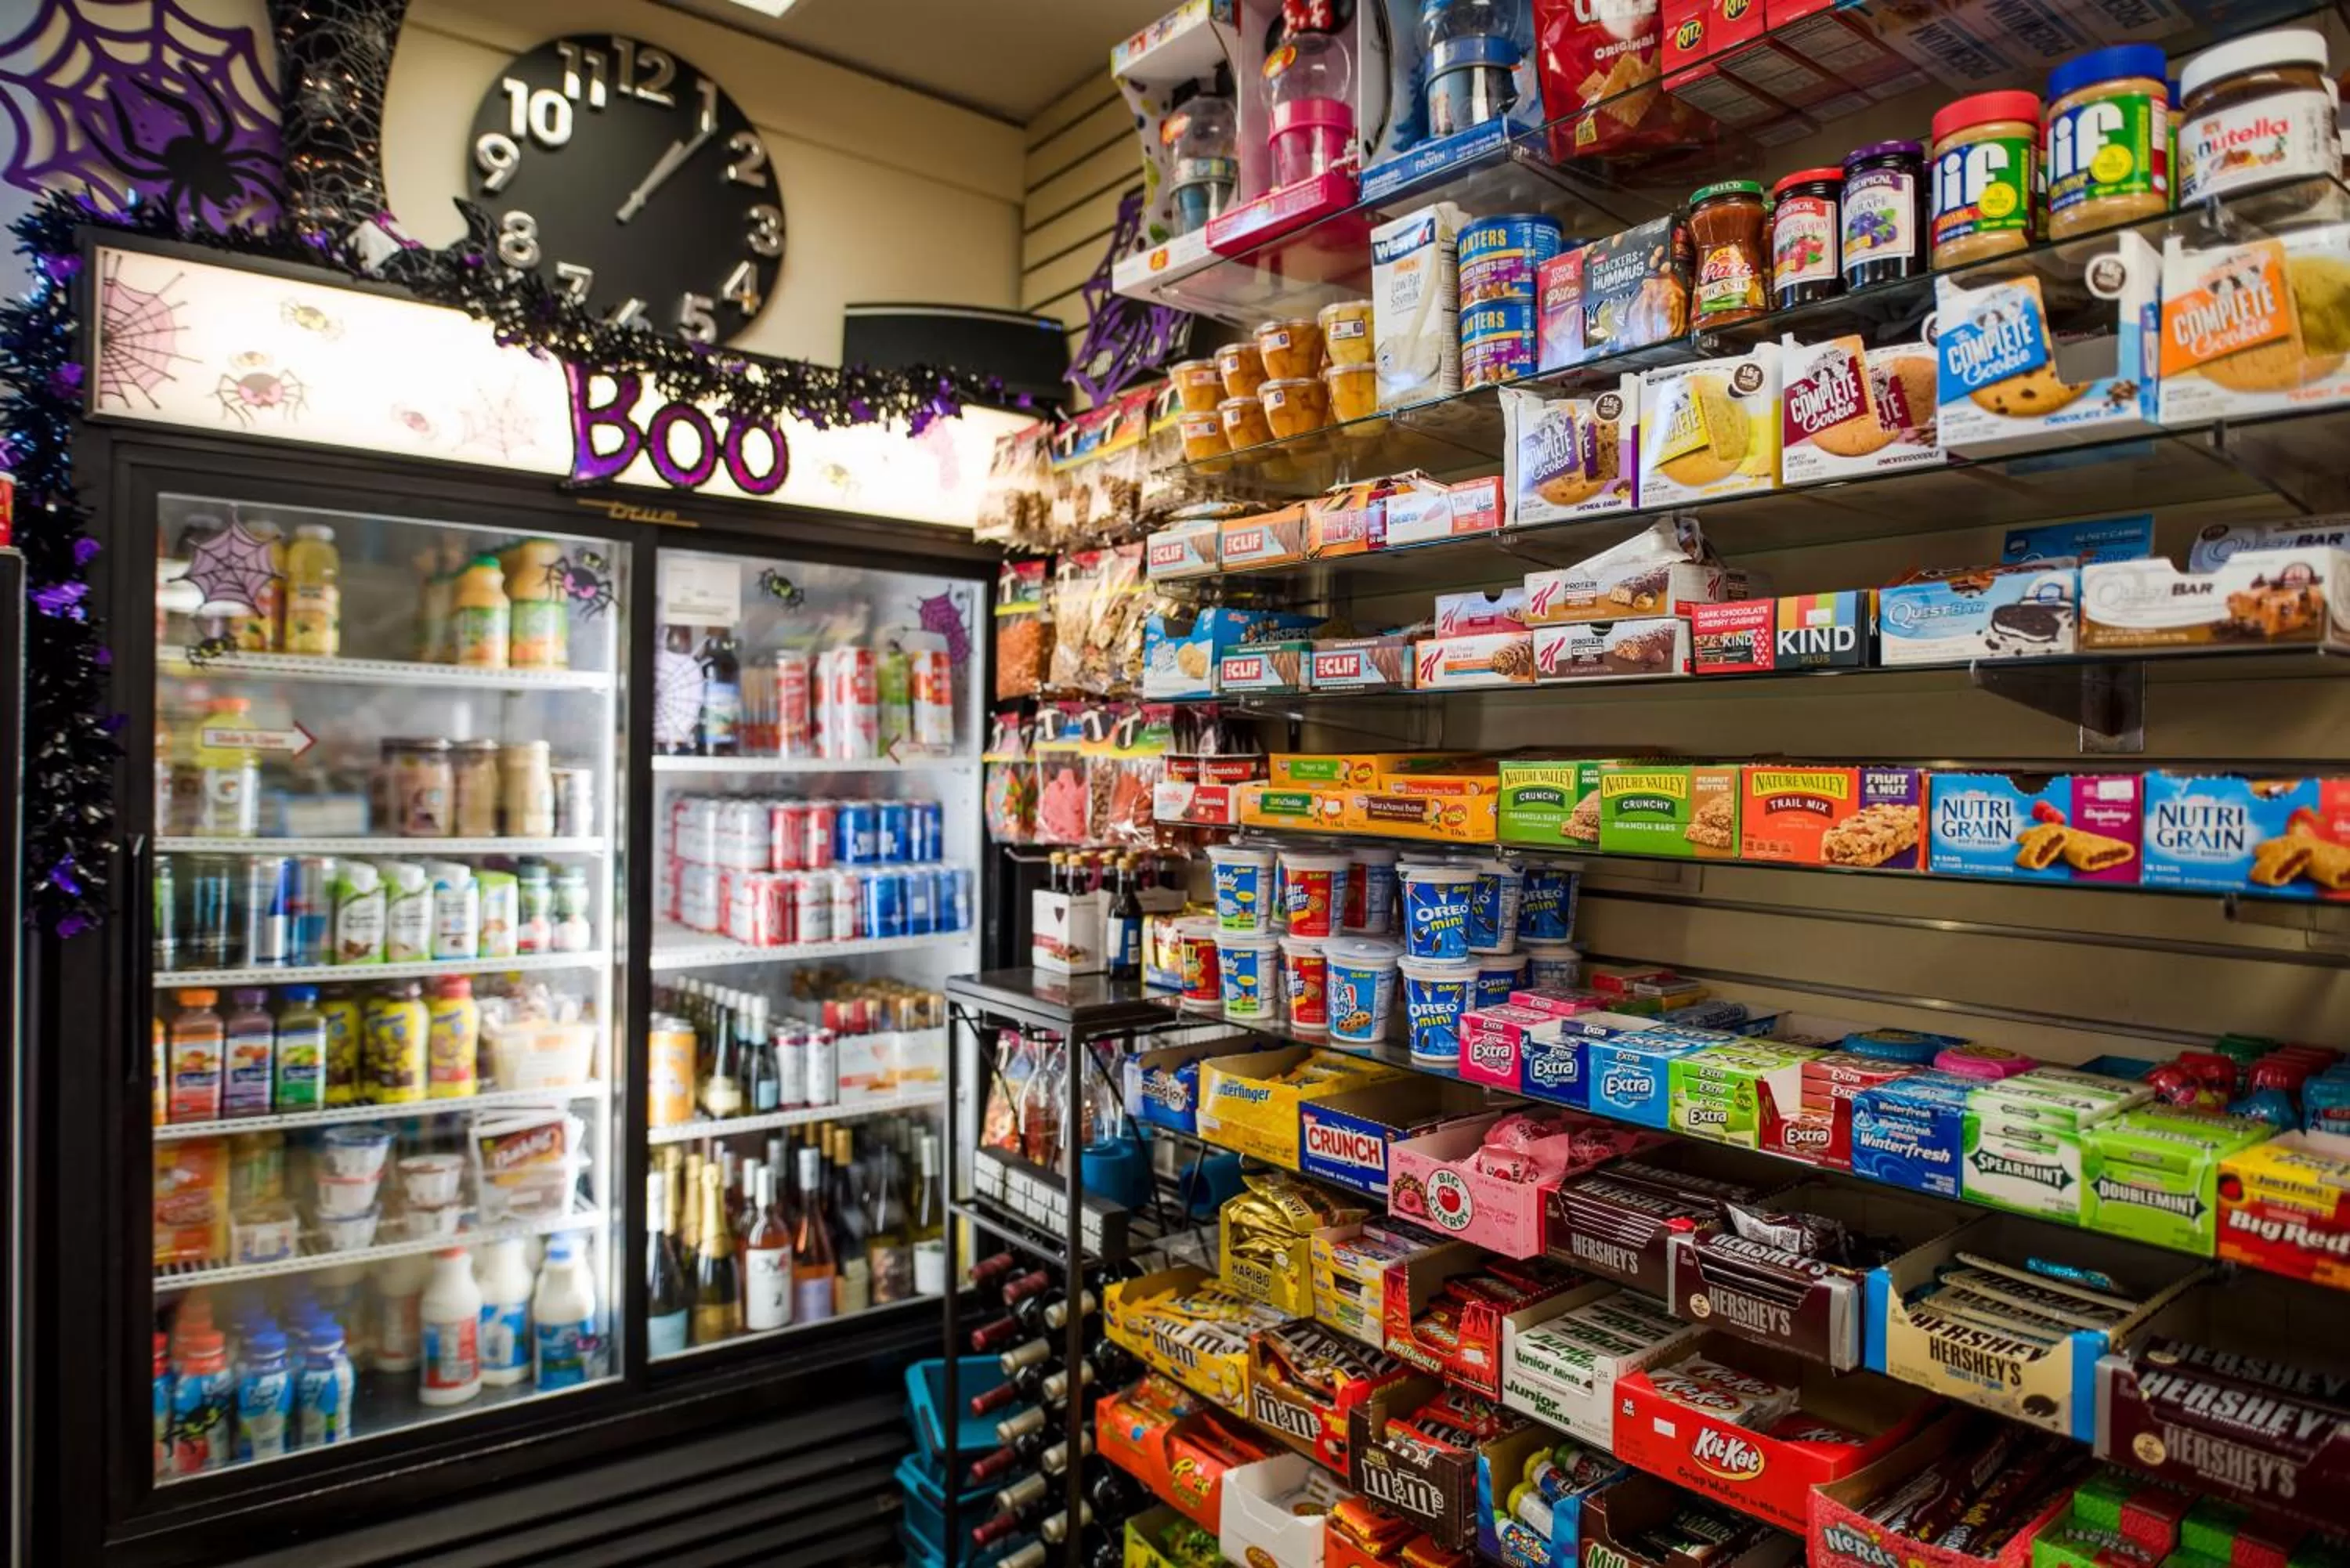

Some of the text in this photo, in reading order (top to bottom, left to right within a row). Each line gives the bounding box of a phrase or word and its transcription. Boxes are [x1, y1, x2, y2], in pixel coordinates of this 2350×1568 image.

[1676, 21, 1704, 49] RITZ
[1593, 34, 1656, 60] ORIGINAL
[558, 40, 607, 107] 11
[611, 35, 676, 108] 12
[502, 77, 573, 146] 10
[696, 78, 719, 132] 1
[2046, 101, 2124, 188] Jif
[2198, 117, 2290, 157] nutella
[475, 132, 520, 191] 9
[727, 130, 768, 188] 2
[1932, 142, 2009, 219] Jif
[498, 210, 542, 268] 8
[747, 203, 784, 257] 3
[556, 260, 595, 303] 7
[722, 260, 761, 315] 4
[1593, 262, 1644, 292] HUMMUS
[678, 291, 717, 343] 5
[2171, 282, 2276, 345] COMPLETE
[1947, 316, 2034, 376] COMPLETE
[2191, 318, 2272, 359] Cookie
[1962, 349, 2031, 386] Cookie
[1790, 365, 1859, 424] COMPLETE
[1802, 402, 1857, 432] Cookie
[1233, 531, 1261, 553] CLIF
[2296, 532, 2344, 547] BAR
[1158, 544, 1184, 562] CLIF
[2171, 580, 2214, 597] BAR
[1697, 606, 1768, 620] DARK CHOCOLATE
[1697, 617, 1729, 627] CHERRY
[1723, 634, 1754, 648] KIND
[1776, 626, 1856, 656] KIND
[1231, 660, 1260, 679] CLIF
[1325, 656, 1358, 676] CLIF
[1503, 769, 1573, 785] NATURE VALLEY
[1603, 775, 1687, 796] NATURE VALLEY
[1753, 773, 1846, 796] NATURE VALLEY
[1865, 773, 1908, 784] FRUIT
[1518, 790, 1560, 802] CRUNCHY
[1880, 784, 1908, 796] NUT
[1622, 799, 1671, 811] CRUNCHY
[1769, 797, 1829, 814] TRAIL MIX
[1942, 798, 2011, 818] NUTRI
[2159, 803, 2245, 826] NUTRI
[1654, 822, 1676, 832] BARS
[1941, 820, 2012, 840] GRAIN
[2157, 829, 2245, 851] GRAIN
[1415, 905, 1469, 922] OREO
[1430, 917, 1464, 931] mini
[1410, 1003, 1458, 1016] OREO
[1418, 1014, 1452, 1028] mini
[1483, 1019, 1504, 1031] Extra
[1582, 1024, 1607, 1036] Extra
[1472, 1044, 1510, 1060] Extra
[1549, 1046, 1572, 1058] Extra
[1615, 1050, 1640, 1063] Extra
[1534, 1059, 1574, 1078] Extra
[1698, 1066, 1726, 1078] Extra
[1831, 1069, 1861, 1082] Extra
[1605, 1076, 1650, 1094] Extra
[1698, 1082, 1726, 1094] Extra
[1689, 1108, 1727, 1123] Extra
[1879, 1100, 1932, 1119] Winterfresh
[1786, 1128, 1828, 1143] Extra
[1879, 1117, 1932, 1137] Winterfresh
[1308, 1126, 1380, 1165] CRUNCH
[1860, 1131, 1950, 1165] Winterfresh
[1437, 1172, 1459, 1190] BIG
[1978, 1153, 2065, 1187] SPEARMINT
[2099, 1177, 2196, 1217] DOUBLEMINT
[1429, 1194, 1471, 1229] CHERRY
[2229, 1209, 2350, 1255] Big Red
[1571, 1231, 1639, 1275] HERSHEY'S
[1708, 1233, 1827, 1277] HERSHEY'S
[1232, 1263, 1271, 1288] HARIBO
[1708, 1285, 1792, 1336] HERSHEY'S
[1911, 1312, 2048, 1363] HERSHEY
[1929, 1335, 2022, 1386] HERSHEY'S
[1553, 1367, 1580, 1386] Mints
[1504, 1379, 1560, 1411] Junior
[2138, 1369, 2329, 1439] HERSHEY
[1535, 1401, 1571, 1427] Mints
[2163, 1425, 2298, 1500] HERSHEY'S
